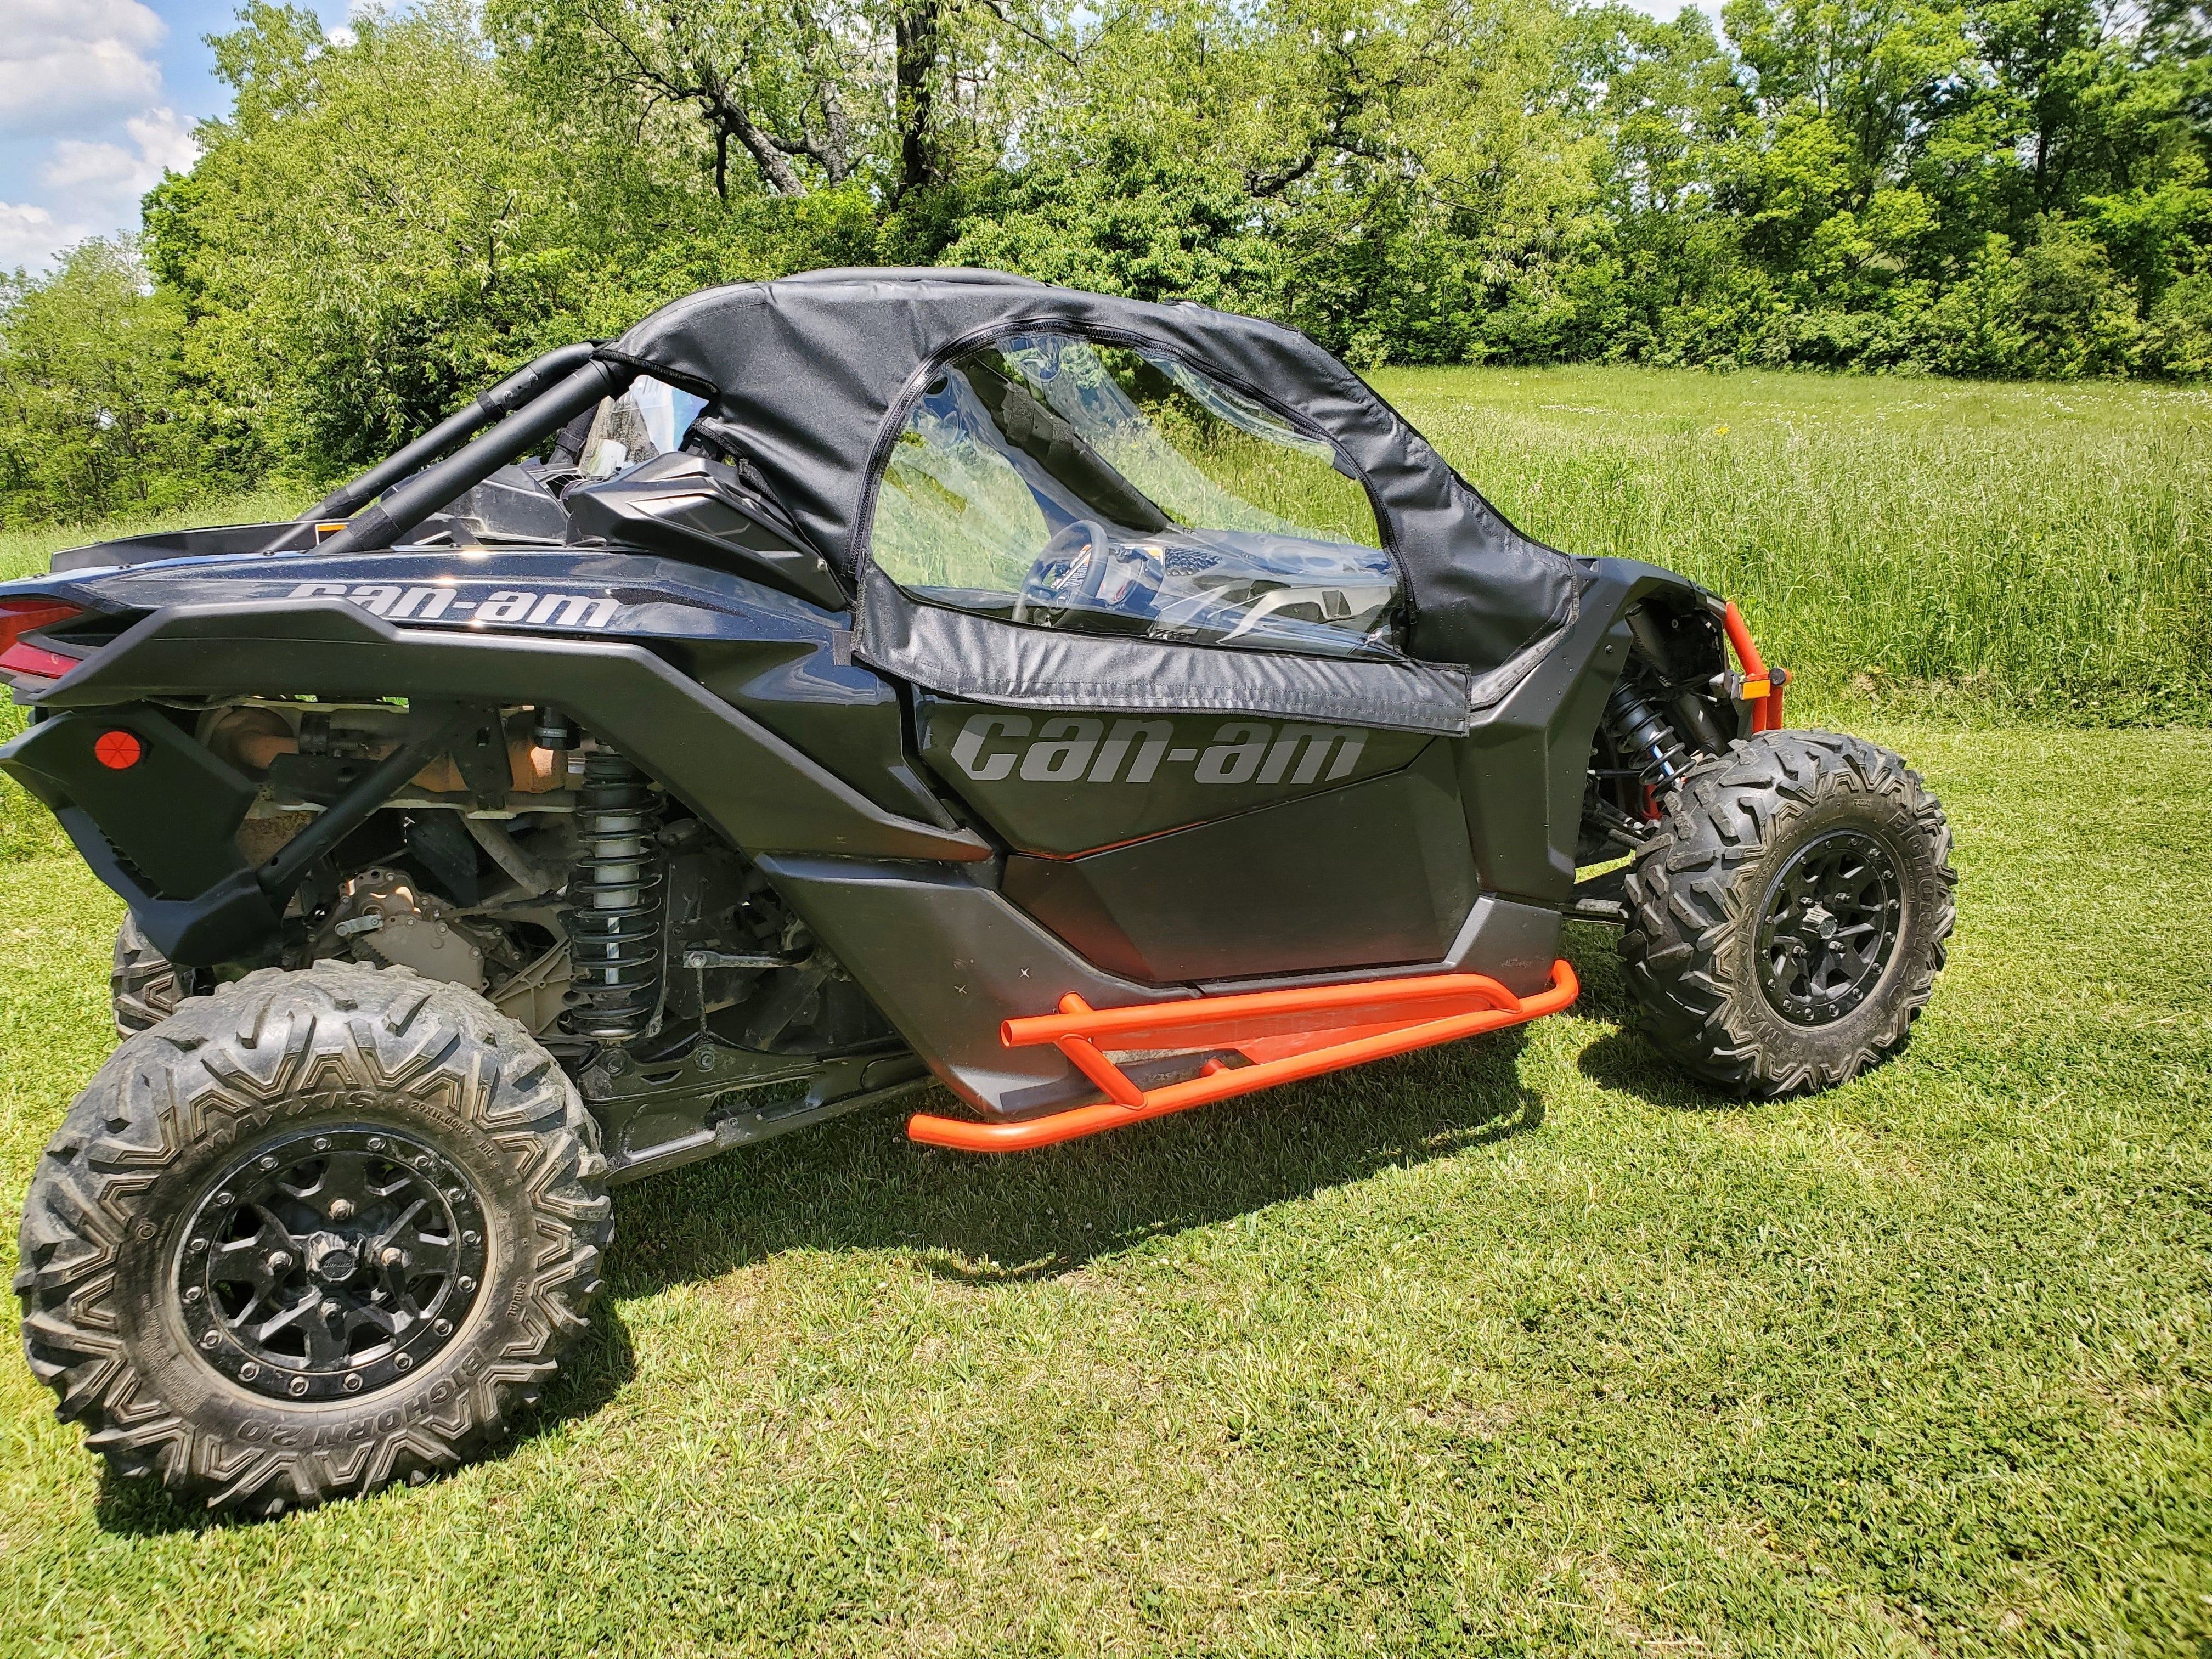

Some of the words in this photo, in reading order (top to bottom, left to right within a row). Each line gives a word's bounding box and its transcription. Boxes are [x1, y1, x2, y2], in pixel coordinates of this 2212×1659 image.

[950, 714, 1370, 785] can-am
[1887, 810, 1936, 955] BIGHORN
[1735, 904, 1782, 1049] MAXXIS
[195, 1090, 377, 1153] MAXXIS
[411, 1100, 476, 1139] 29X11.00R14
[478, 1140, 497, 1160] NHS
[507, 1280, 528, 1317] RADIAL
[314, 1346, 487, 1447] BIGHORN
[237, 1419, 304, 1447] 2.0
